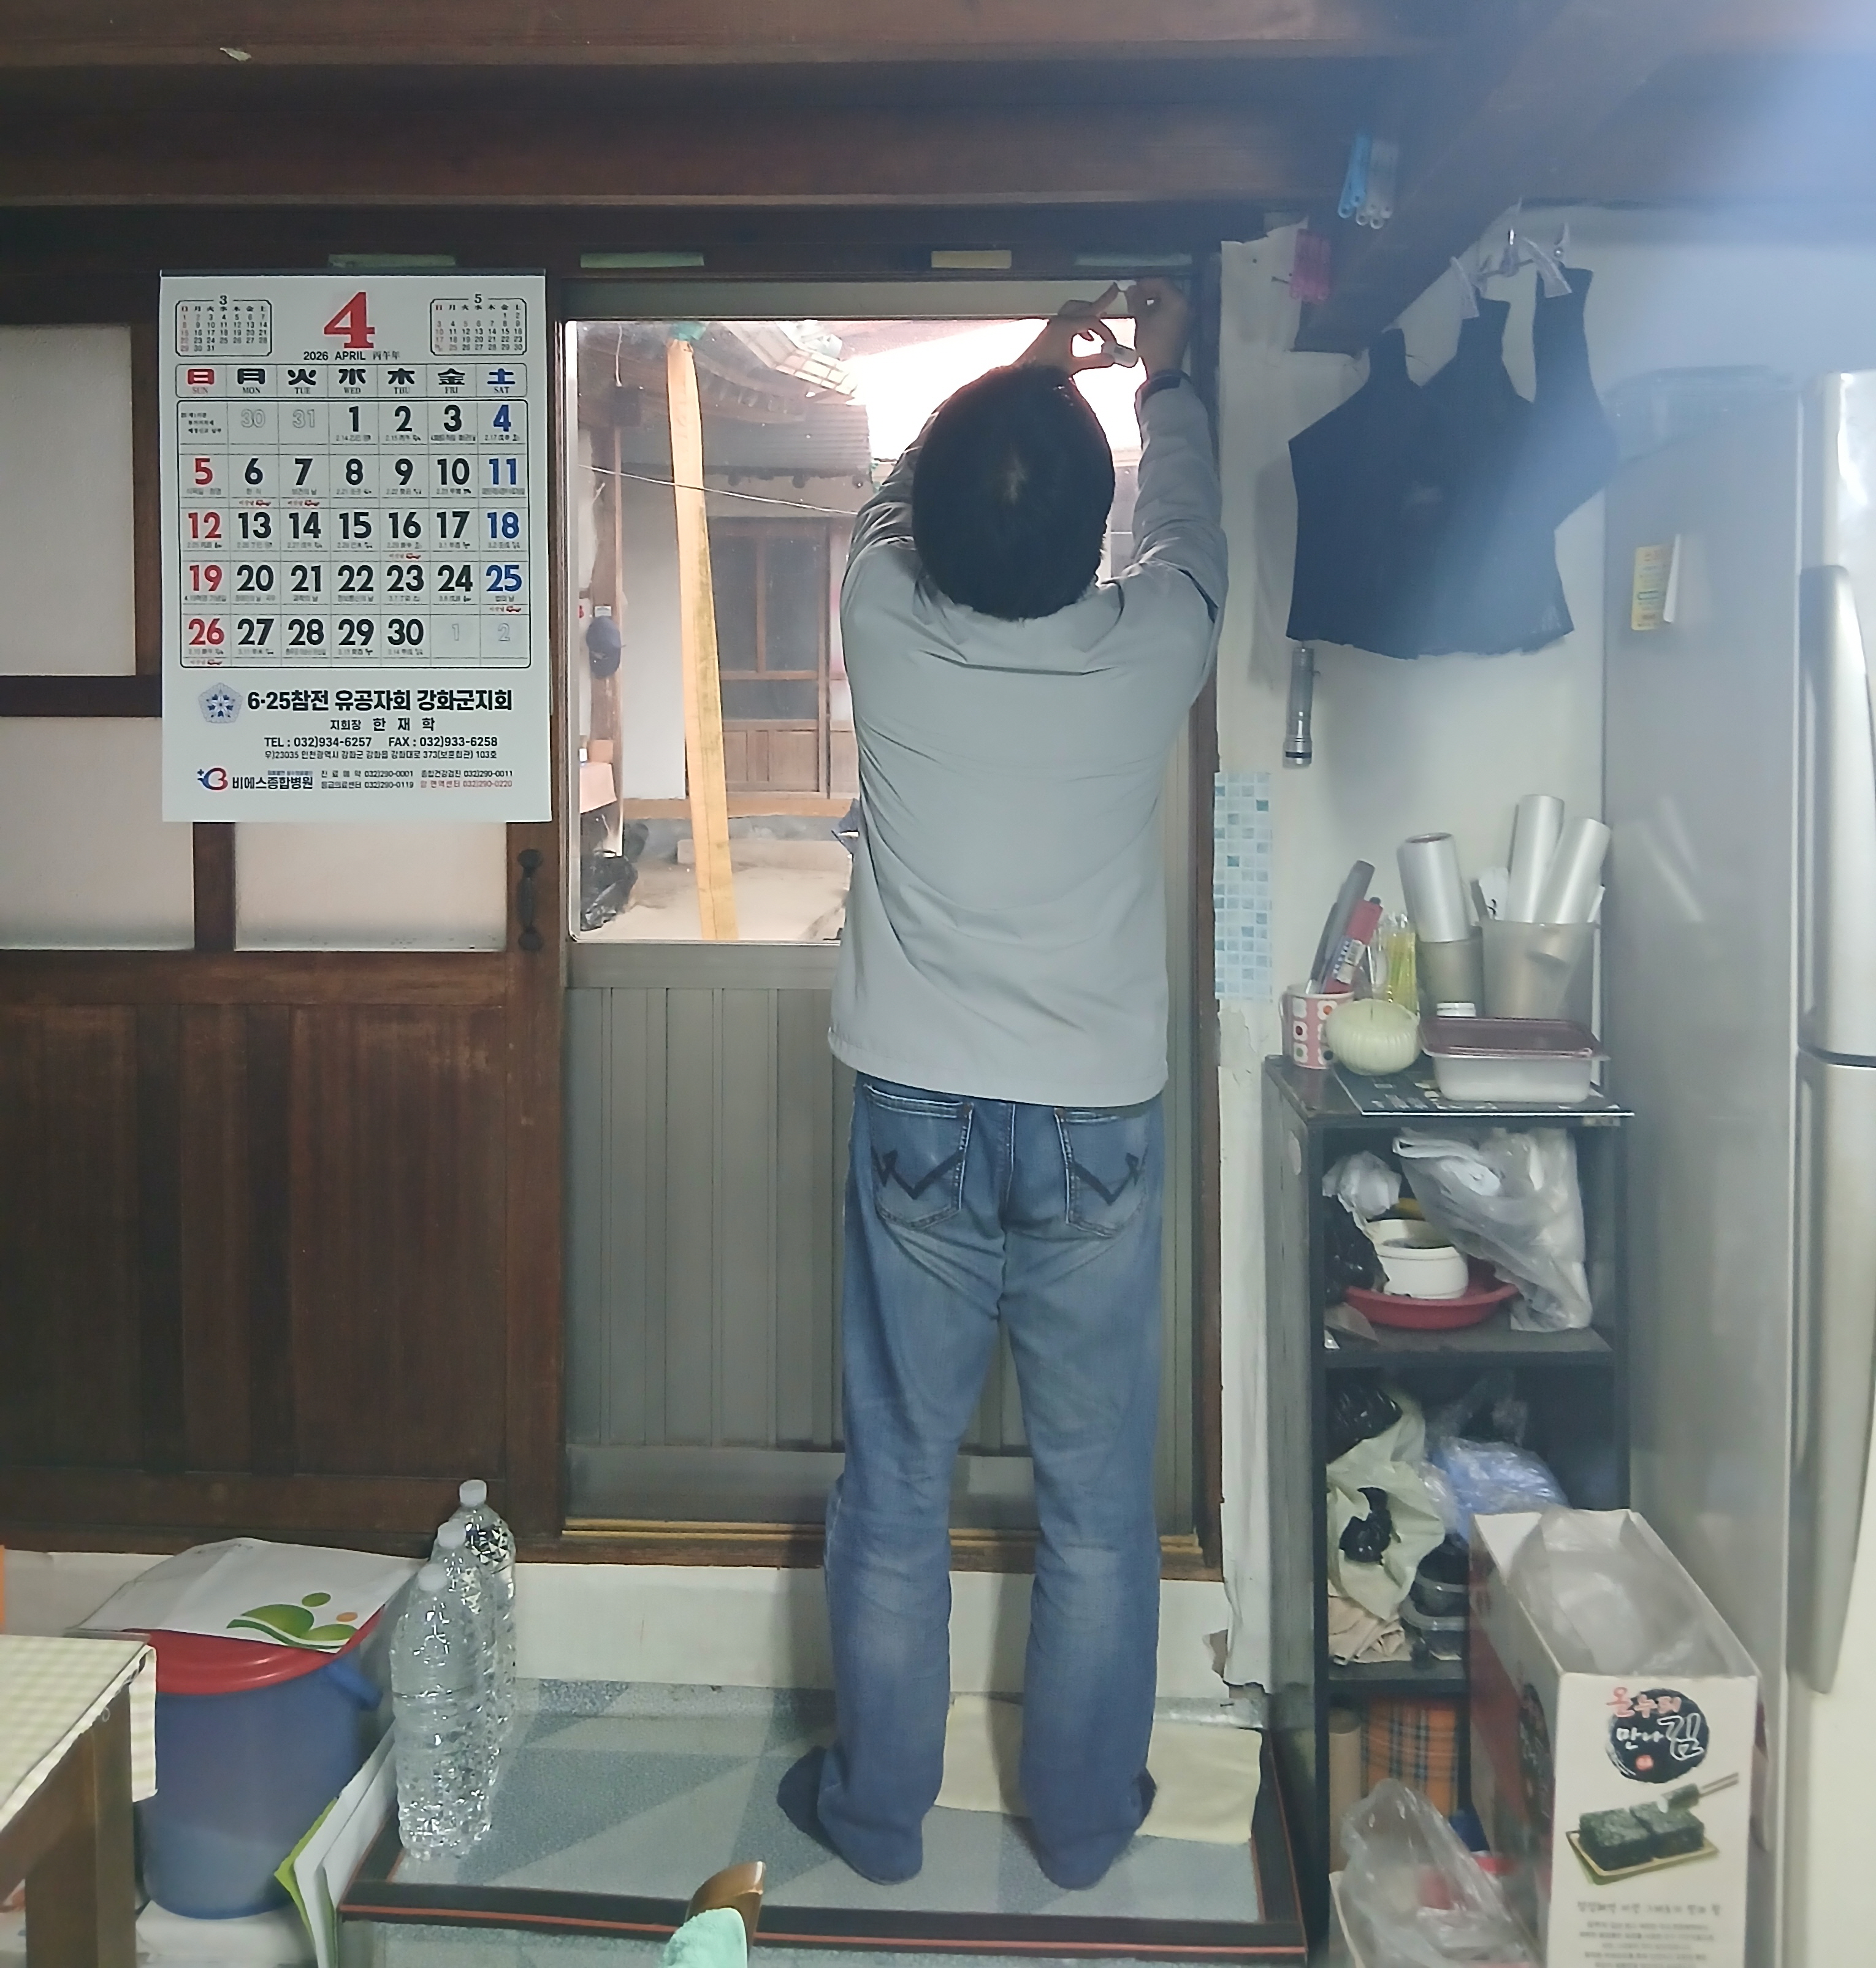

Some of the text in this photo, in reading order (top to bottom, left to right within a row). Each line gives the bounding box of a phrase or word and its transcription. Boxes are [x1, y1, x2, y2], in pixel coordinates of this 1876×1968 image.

[219, 296, 227, 305] 3
[475, 294, 482, 303] 5
[324, 292, 375, 348] 4
[303, 351, 328, 360] 2026
[335, 351, 366, 360] APRIL
[188, 368, 515, 385] 日 月 火 水 木 金 土
[241, 405, 511, 432] 30 31 1 2 3 4
[195, 458, 516, 485] 5 6 7 8 9 10 11
[188, 511, 519, 539] 12 13 14 15 16 17 18
[189, 565, 522, 592] 19 20 21 22 23 24 25
[189, 619, 510, 646] 26 27 28 29 30 1 2
[248, 690, 511, 711] 6·25참전 유공자회 강화군지회
[330, 717, 435, 731] 지회장 한 재 학
[264, 738, 284, 747] TEL
[294, 736, 372, 747] 032)934-6257
[389, 737, 410, 746] FAX
[420, 736, 497, 747] 032)933-6258
[342, 750, 363, 759] 강화군
[392, 750, 420, 759] 강화대로
[232, 777, 313, 789] 비에스종합병원
